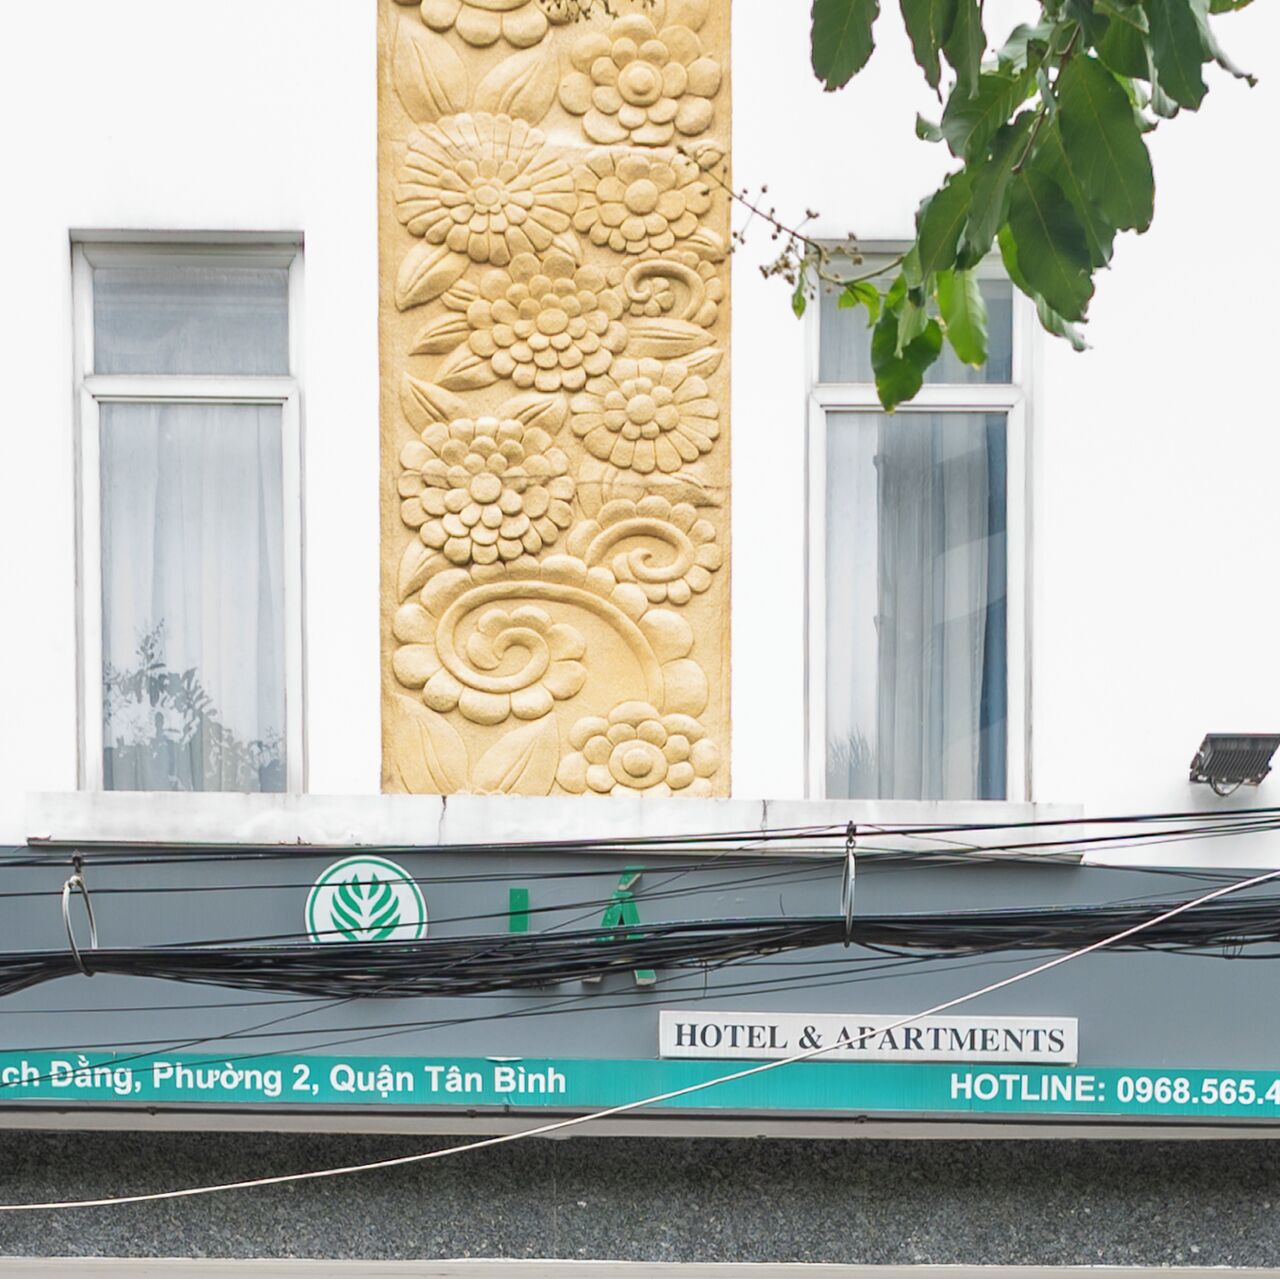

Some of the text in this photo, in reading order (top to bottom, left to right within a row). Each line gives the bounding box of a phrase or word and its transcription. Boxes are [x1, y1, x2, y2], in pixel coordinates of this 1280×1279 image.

[675, 1023, 1065, 1053] HOTEL & APARTMENTS
[152, 1062, 283, 1097] Phường
[292, 1064, 319, 1096] 2,
[329, 1064, 414, 1098] Quận
[425, 1066, 483, 1093] Tân
[494, 1065, 566, 1094] Bình
[950, 1073, 1106, 1102] HOTLINE:
